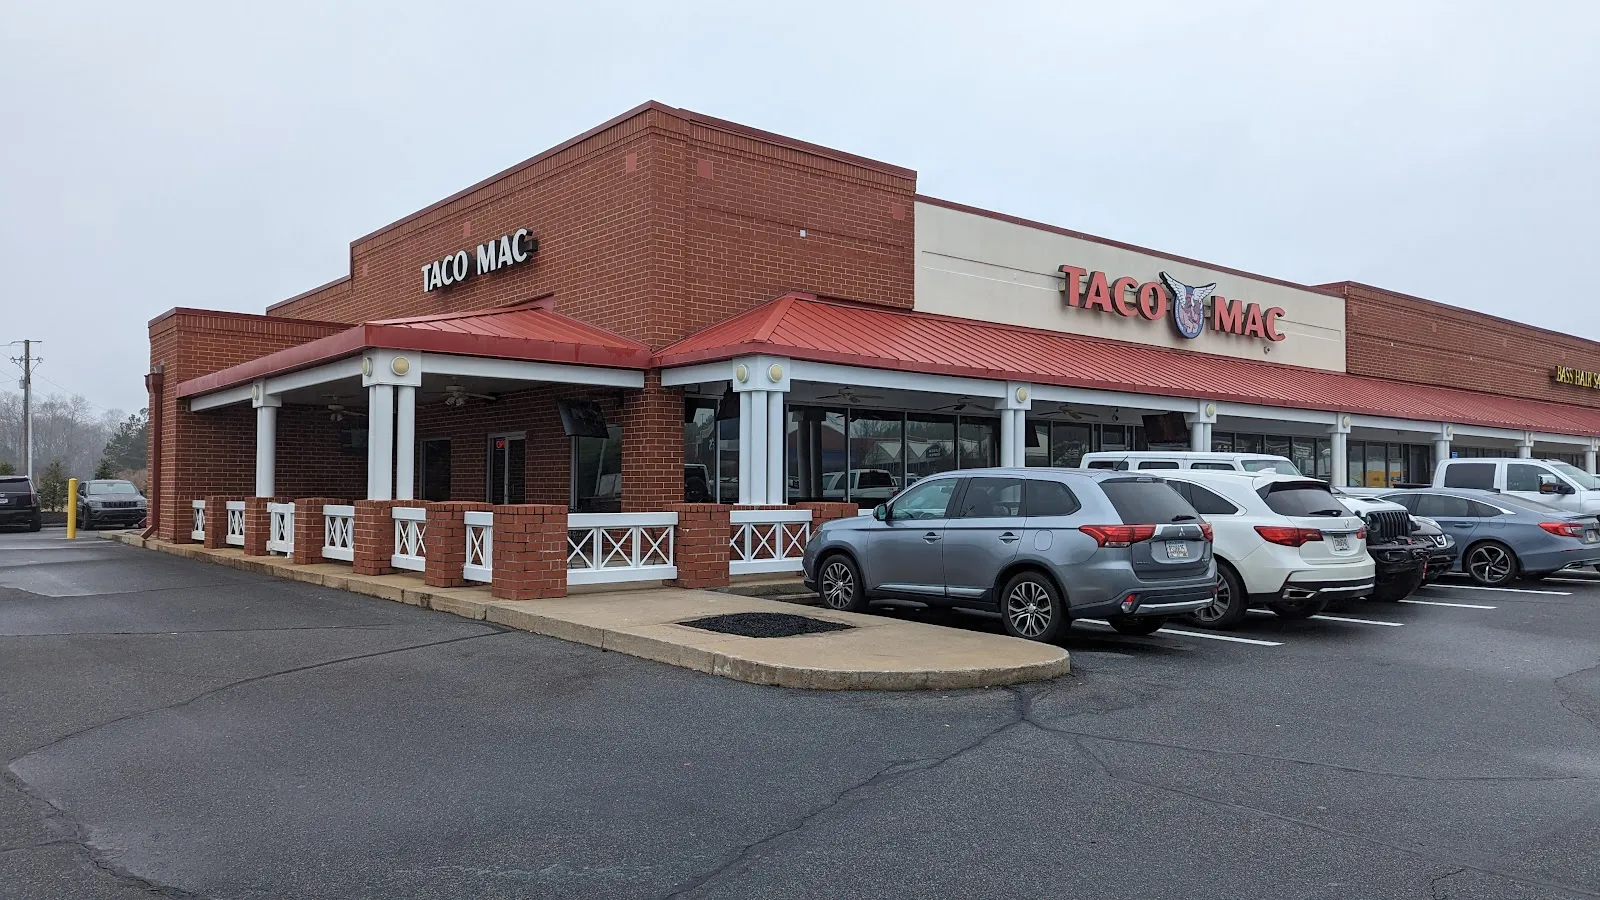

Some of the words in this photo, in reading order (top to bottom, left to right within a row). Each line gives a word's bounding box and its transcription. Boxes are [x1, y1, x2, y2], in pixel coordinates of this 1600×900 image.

[421, 250, 468, 292] TACO
[477, 228, 528, 275] MAC
[1058, 264, 1168, 320] TACO
[1211, 296, 1286, 341] MAC
[1556, 365, 1574, 384] BASS
[1575, 369, 1592, 387] HAIR
